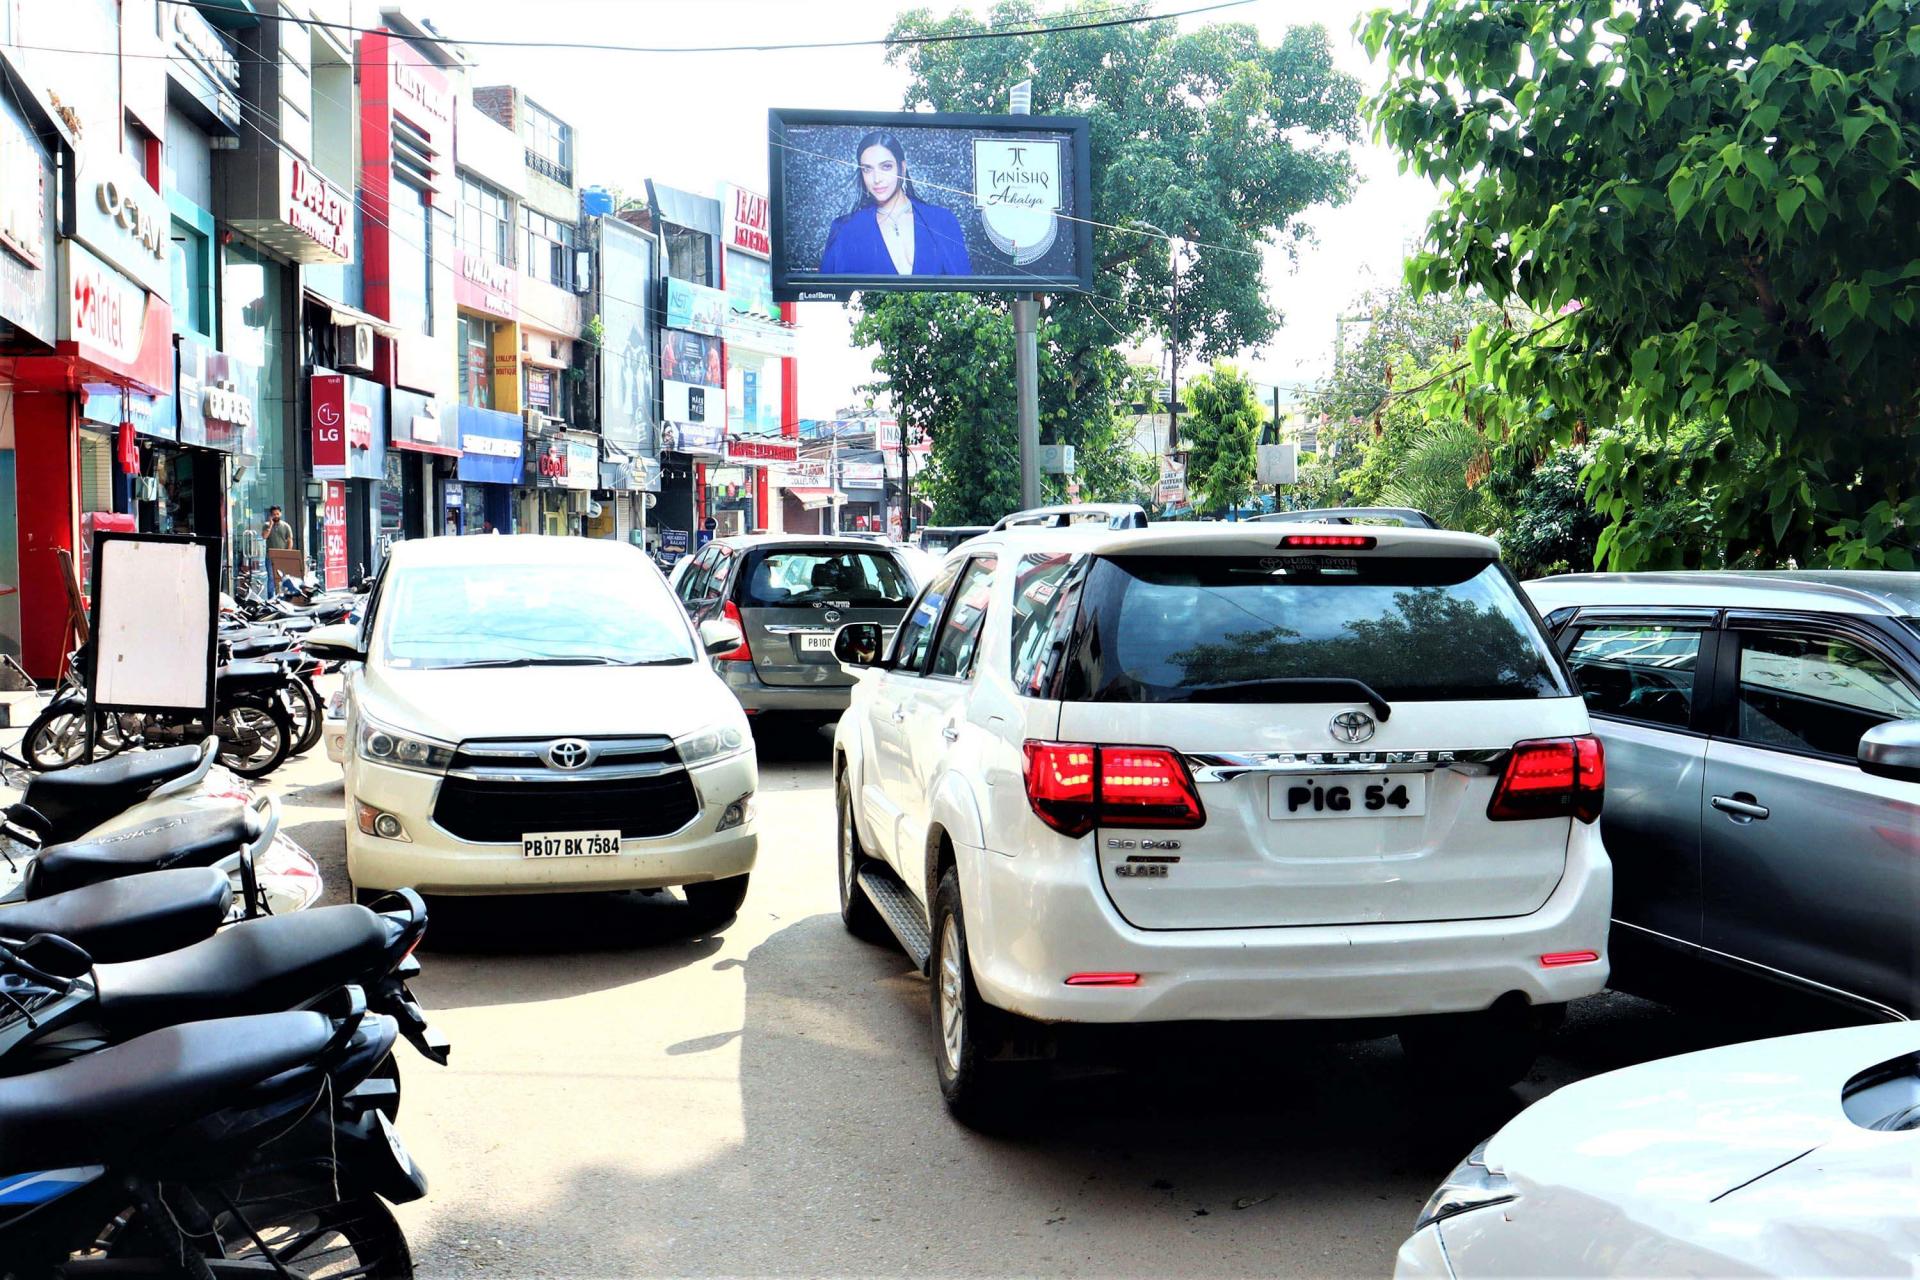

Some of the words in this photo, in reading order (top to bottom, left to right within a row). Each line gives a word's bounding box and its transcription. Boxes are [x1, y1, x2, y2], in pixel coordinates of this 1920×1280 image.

[988, 167, 1049, 190] TANISHQ
[89, 271, 123, 350] airtel
[202, 379, 252, 428] adidas
[319, 428, 339, 442] LG
[325, 505, 345, 526] SALE
[1250, 751, 1455, 764] FORTUNER
[1287, 786, 1351, 813] PIG
[1364, 784, 1411, 811] 54
[523, 839, 561, 857] PB07
[564, 838, 584, 855] BK
[586, 836, 620, 855] 7584
